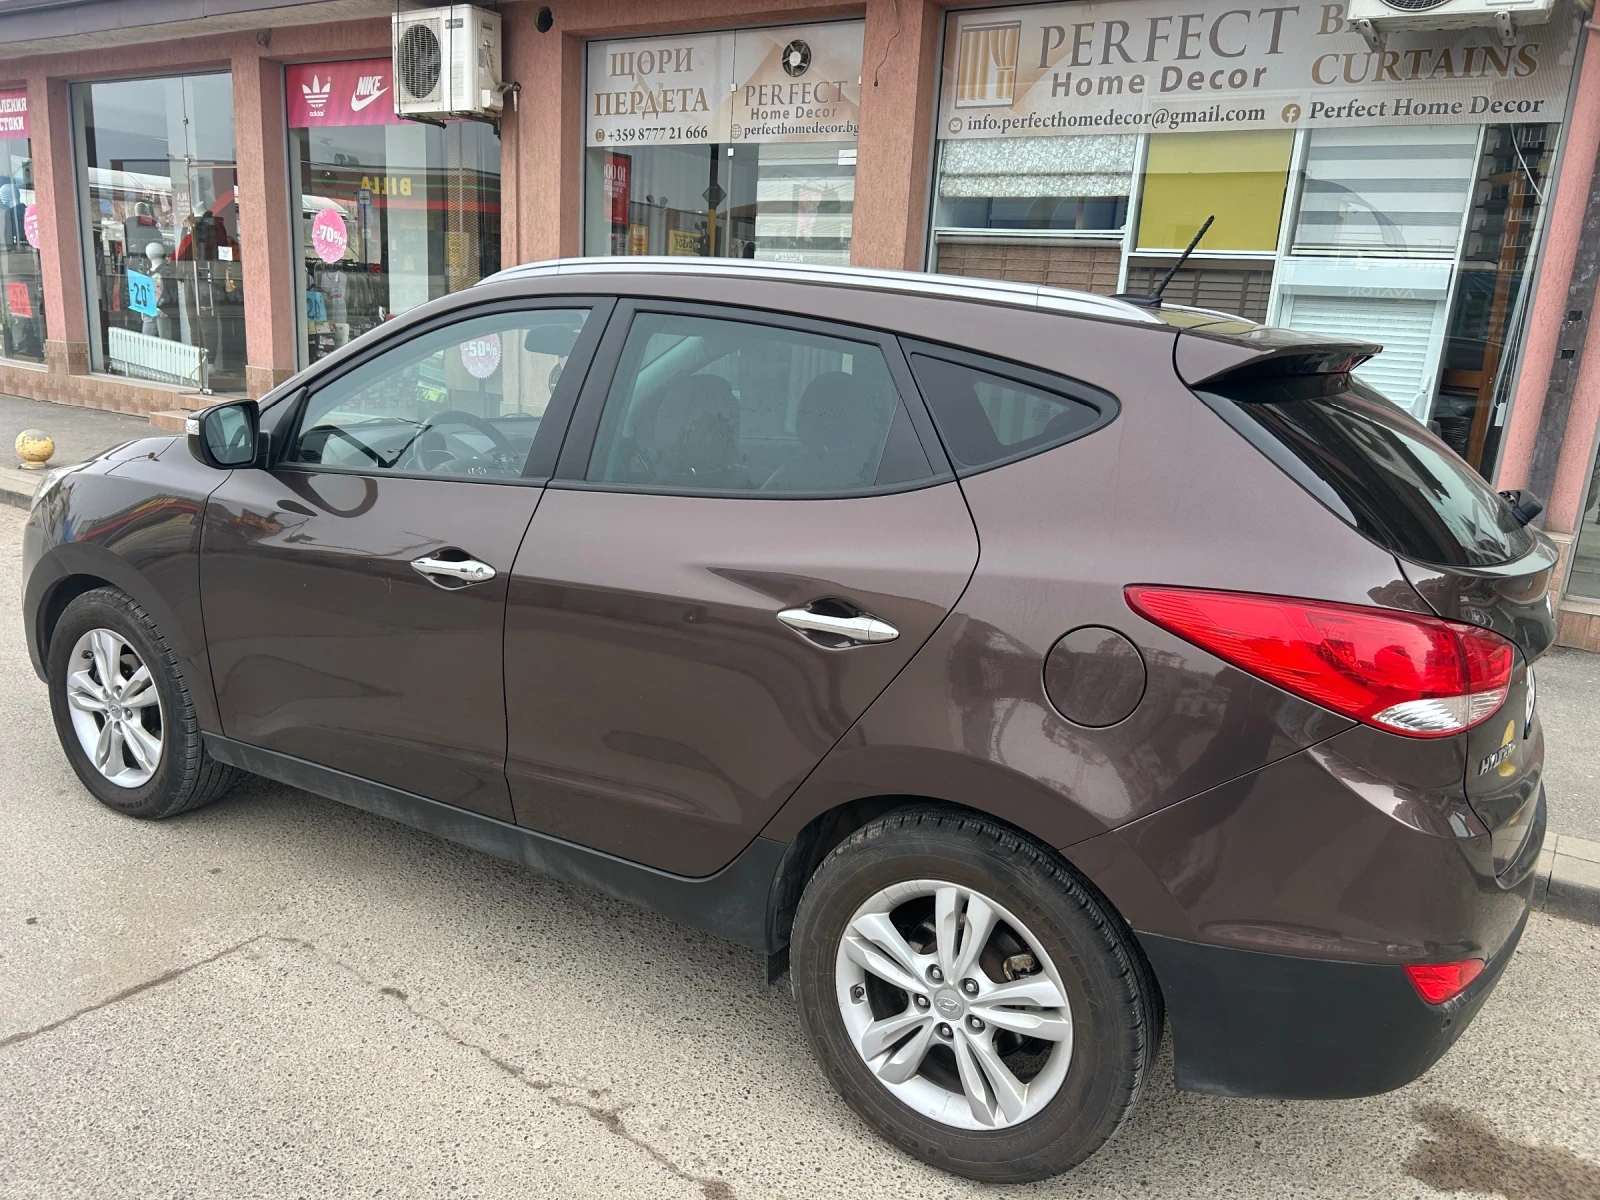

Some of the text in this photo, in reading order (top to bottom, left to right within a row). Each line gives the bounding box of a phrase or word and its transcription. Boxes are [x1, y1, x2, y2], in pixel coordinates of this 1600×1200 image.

[1038, 6, 1299, 68] PERFECT
[609, 47, 694, 82] ЩОРИ
[1311, 43, 1540, 85] CURTAINS
[356, 76, 382, 96] NIKE
[744, 80, 848, 106] PERFECT
[1051, 66, 1267, 98] Home Decor
[0, 97, 27, 113] ЛЕНИЯ
[594, 87, 710, 120] ПЕРДЕТА
[750, 106, 838, 120] Home Decor
[1309, 95, 1544, 119] Perfect Home Decor
[743, 121, 859, 139] perfecthomedecor.bg
[967, 104, 1266, 135] info.perfecthomedecor@gmail.com
[608, 125, 708, 142] +359 8777 21 666
[316, 224, 344, 246] -70%
[464, 340, 498, 357] -50%
